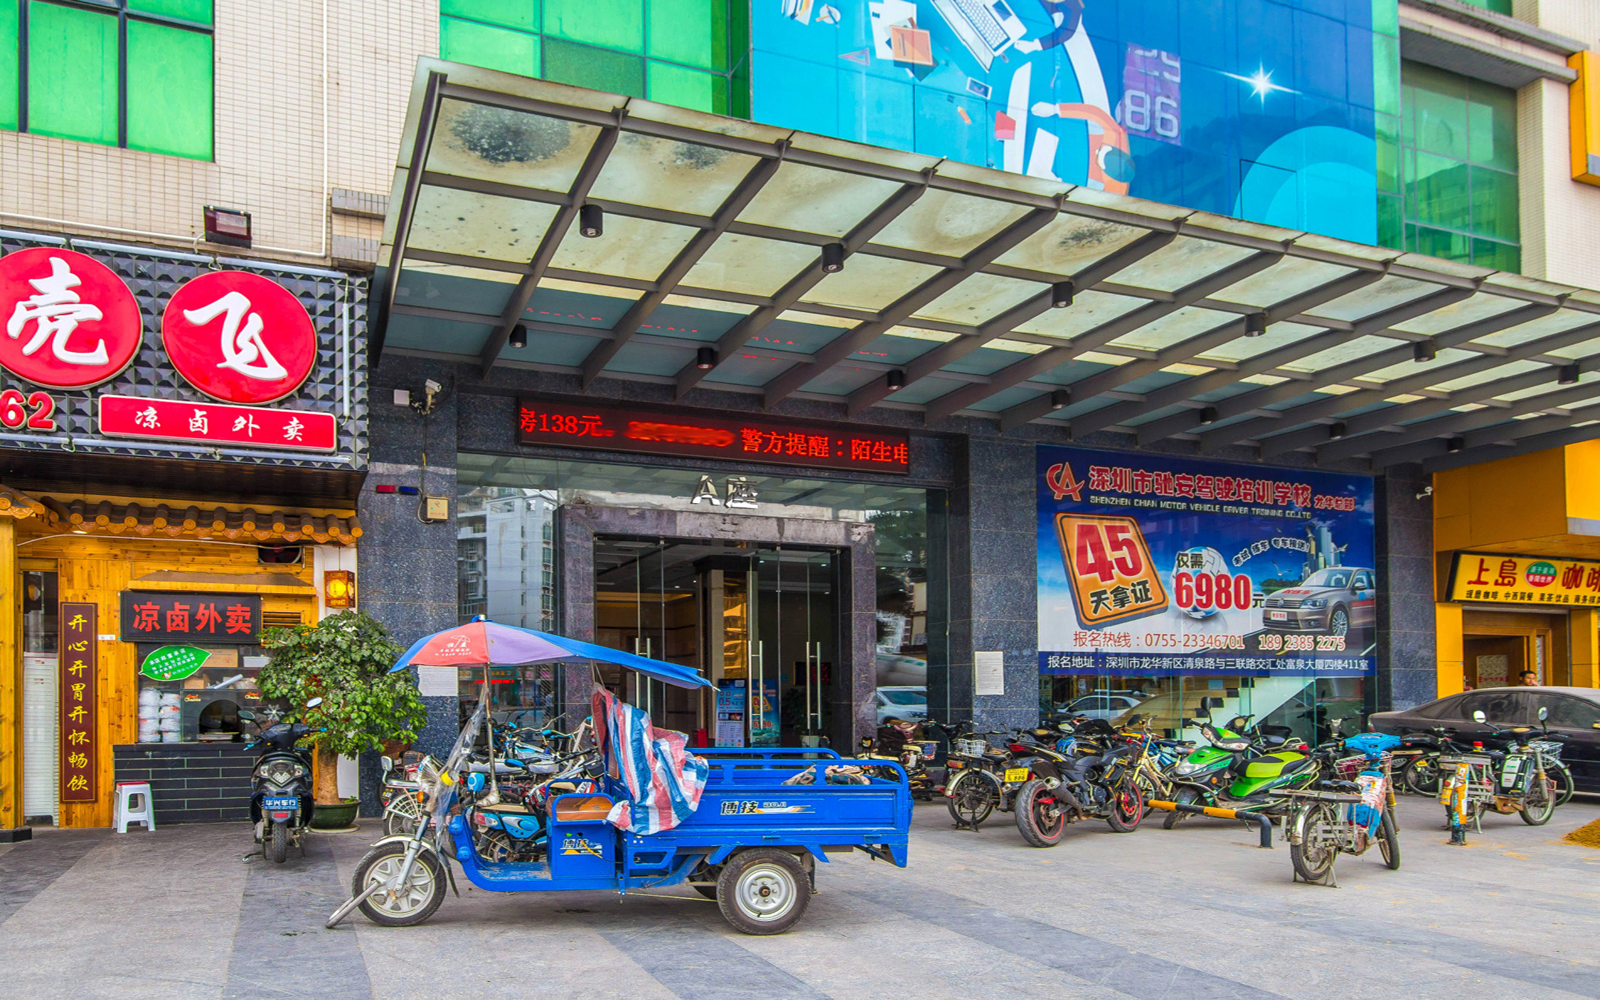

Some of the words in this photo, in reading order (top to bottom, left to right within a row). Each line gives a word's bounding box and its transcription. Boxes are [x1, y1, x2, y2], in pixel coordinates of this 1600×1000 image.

[135, 408, 305, 442] 凉卤外卖
[1088, 465, 1312, 508] 深圳市驰安驾驶培训学校
[1089, 496, 1131, 506] SHENZHEN
[1160, 501, 1187, 510] MOTOR
[1190, 503, 1220, 513] VEHICLE
[1075, 524, 1143, 583] 45
[1176, 553, 1204, 569] 仅需
[1090, 579, 1153, 614] 天拿证
[133, 601, 252, 635] 凉卤外卖
[1259, 634, 1282, 649] 189
[1284, 635, 1314, 650] 2385
[1317, 636, 1345, 651] 2275
[67, 613, 91, 791] 开心开胃开怀畅饮
